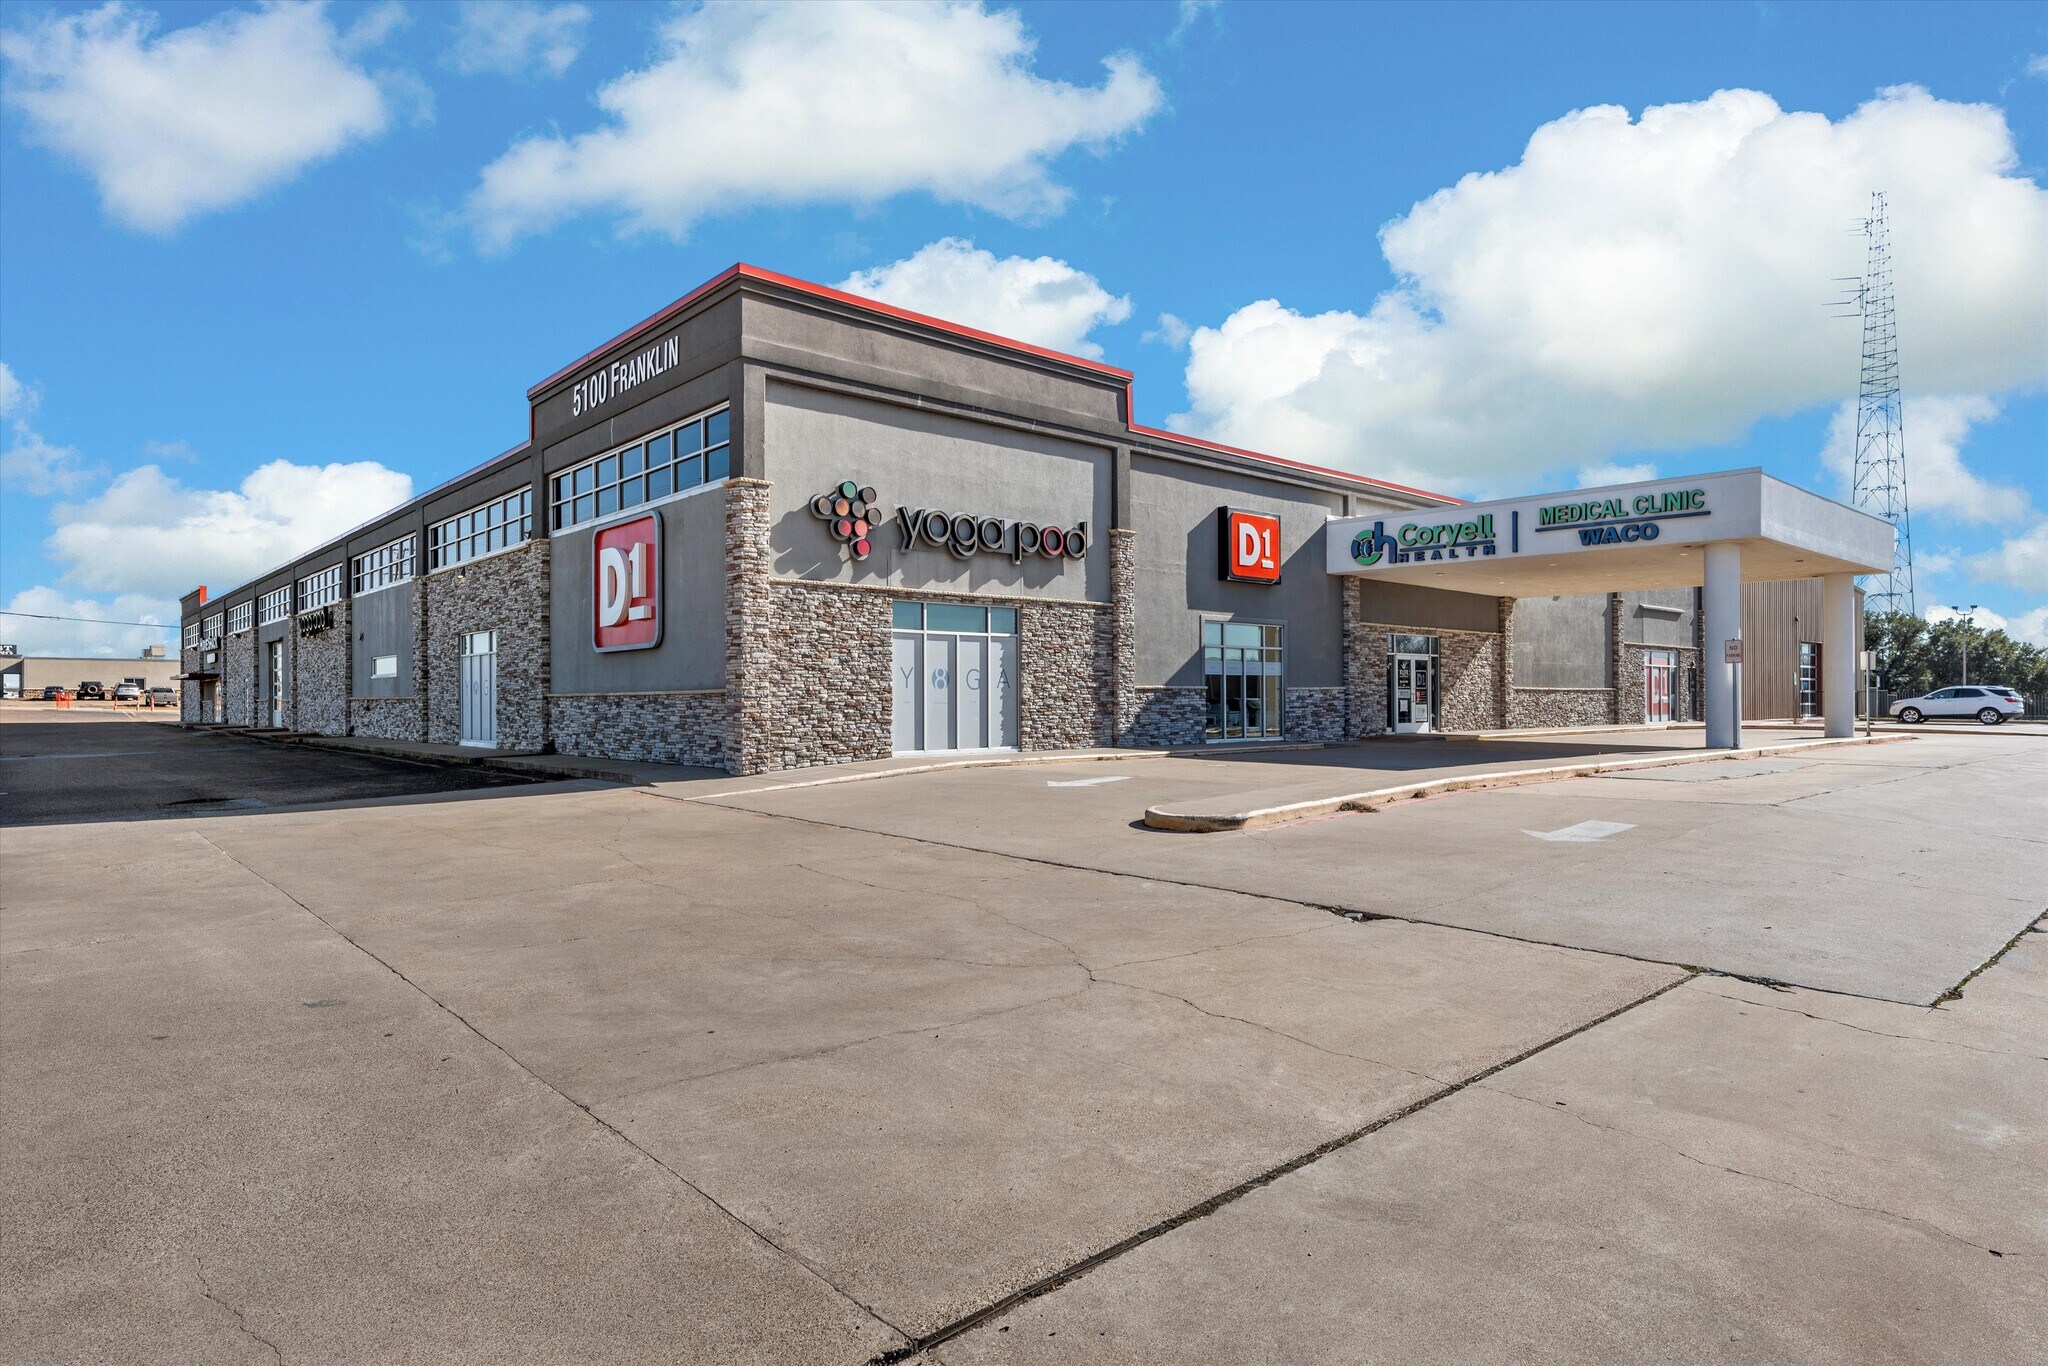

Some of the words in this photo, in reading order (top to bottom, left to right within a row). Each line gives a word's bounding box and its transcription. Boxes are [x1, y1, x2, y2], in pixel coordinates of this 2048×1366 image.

[573, 370, 607, 417] 5100
[611, 336, 679, 398] FRANKLIN
[1539, 499, 1629, 525] MEDICAL
[1633, 489, 1705, 513] CLINIC
[1239, 523, 1275, 569] D1
[1398, 514, 1496, 547] Coryell
[1578, 523, 1660, 546] WACO
[1398, 545, 1496, 563] HEALTH
[600, 542, 652, 627] D1
